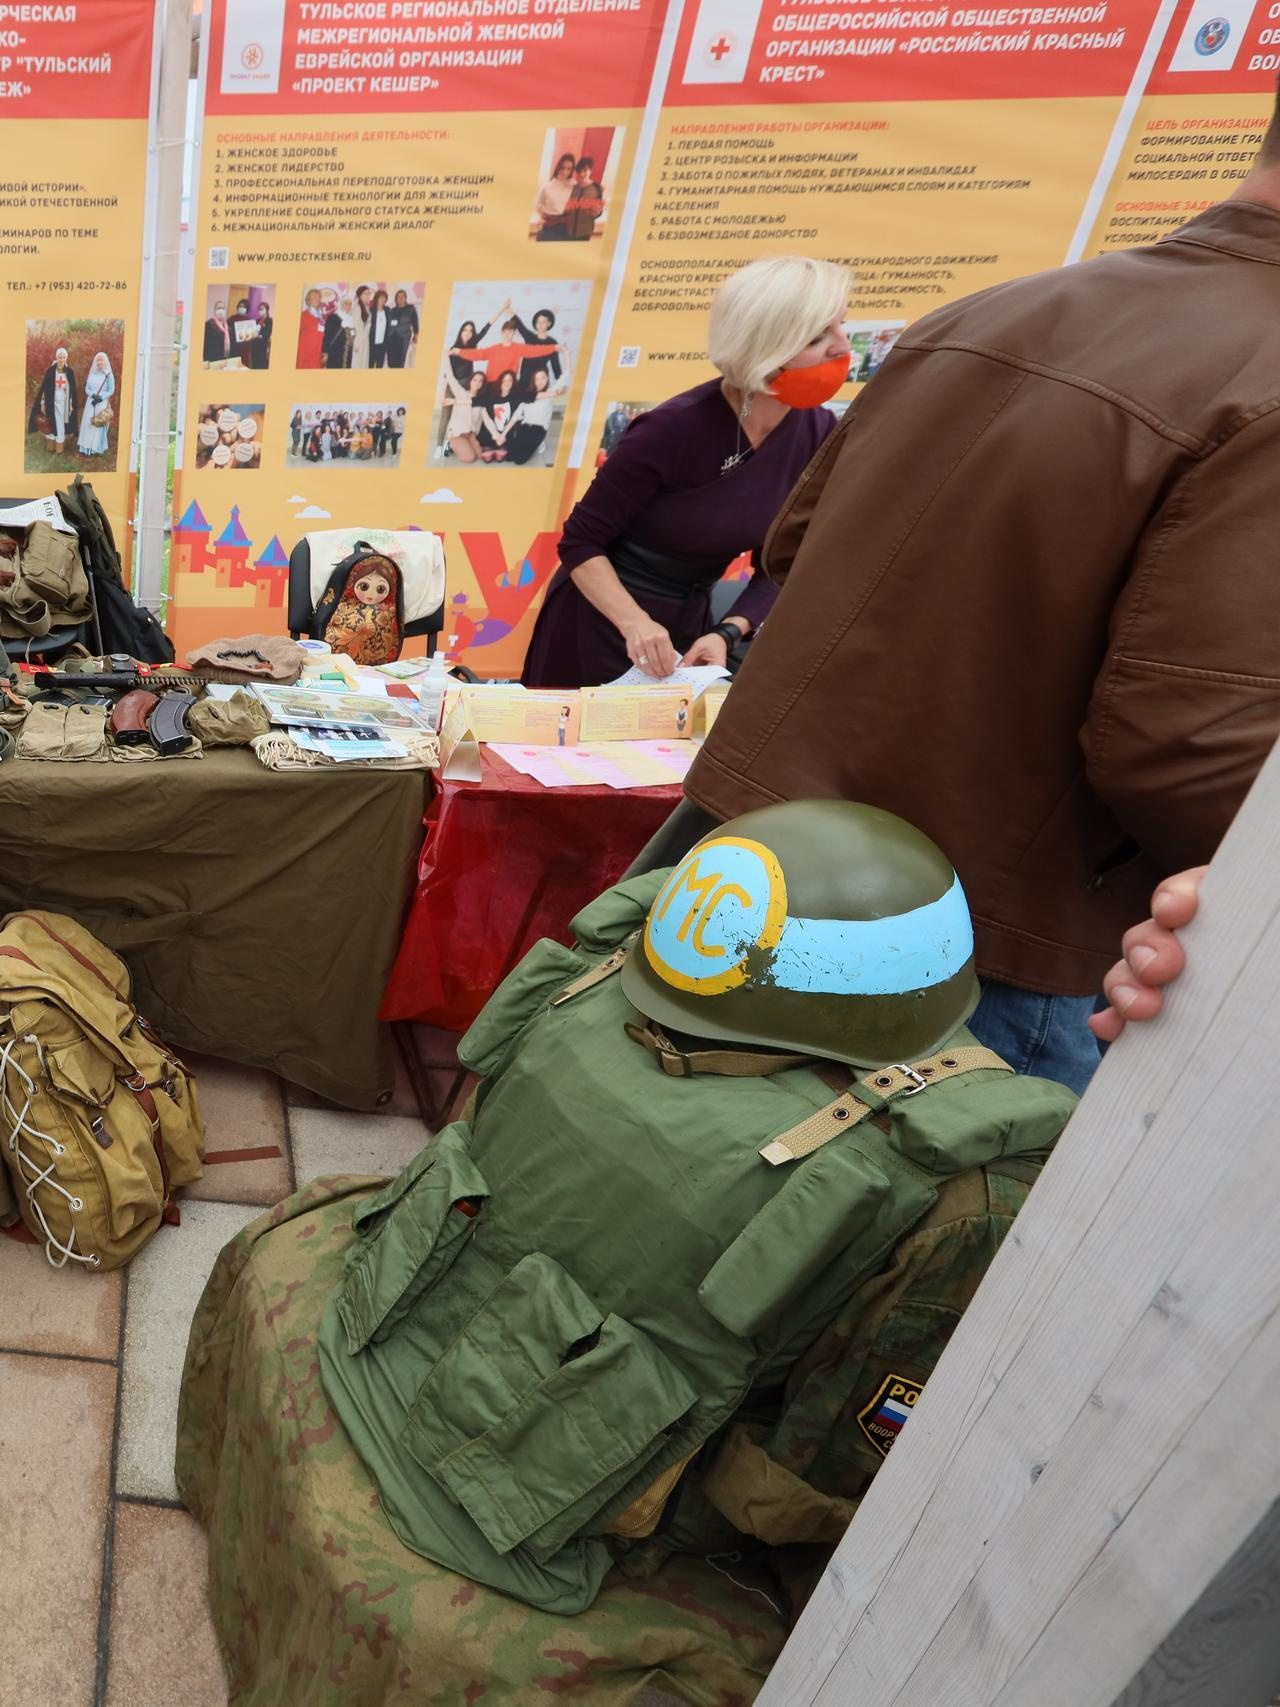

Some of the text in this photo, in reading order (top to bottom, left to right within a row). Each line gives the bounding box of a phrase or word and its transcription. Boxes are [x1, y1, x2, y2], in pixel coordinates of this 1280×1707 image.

[300, 0, 641, 20] ТУЛЬСКОЕ РЕГИОНАЛЬНОЕ ОТДЕЛЕНИЕ
[773, 2, 1107, 32] ОБЩЕРОССИЙСКОЙ ОБЩЕСТВЕННОЙ
[297, 18, 565, 45] МЕЖРЕГИОНАЛЬНОЙ ЖЕНСКОЙ
[765, 27, 1126, 58] ОРГАНИЗАЦИИ «РОССИЙСКИЙ КРАСНЫЙ
[16, 53, 111, 73] "ТУЛЬСКИЙ
[295, 48, 523, 70] ЕВРЕЙСКОЙ ОРГАНИЗАЦИИ
[759, 65, 825, 83] КРЕСТ»
[292, 76, 439, 94] «ПРОЕКТ КЕШЕР»
[671, 121, 890, 135] НАПРАВЛЕНИЯ РАБОТЫ ОРГАНИЗАЦИИ:
[1146, 121, 1178, 131] ЦЕЛЬ
[217, 130, 450, 143] ОСНОВНЫЕ НАПРАВЛЕНИЯ ДЕЯТЕЛЬНОСТИ:
[1141, 135, 1239, 146] ФОРМИРОВАНИЕ
[668, 139, 775, 150] 1. ПЕРВАЯ ПОМОЩЬ
[216, 147, 338, 158] 1. ЖЕНСКОЕ ЗДОРОВЬЕ
[1134, 150, 1216, 164] СОЦИАЛЬНОЙ
[215, 162, 345, 173] 2. ЖЕНСКОЕ ЛИДЕРСТВО
[214, 175, 495, 188] 3. ПРОФЕССИОНАЛЬНАЯ ПЕРЕПОДГОТОВКА ЖЕНЩИН
[1127, 170, 1219, 181] МИЛОСЕРДИЯ В
[30, 196, 118, 207] ОТЕЧЕСТВЕННОЙ
[654, 201, 719, 211] НАСЕЛЕНИЯ
[1115, 201, 1180, 212] ОСНОВНЫЕ
[211, 220, 436, 232] 6. МЕЖНАЦИОНАЛЬНЫЙ ЖЕНСКИЙ ДИАЛОГ
[650, 215, 786, 226] 5. РАБОТА С МОЛОДЕЖЬЮ
[1109, 216, 1187, 227] ВОСПИТАНИЕ
[647, 229, 818, 241] 6. БЕЗВОЗМЕЗДНОЕ ДОНОРСТВО
[1104, 232, 1158, 243] УСЛОВИЙ
[237, 252, 372, 262] WWW.PROJECTKESHER.RU
[7, 281, 127, 291] ТЕЛ.: +7 (953) 420-72-86
[658, 857, 753, 957] МС
[889, 1383, 920, 1406] РО
